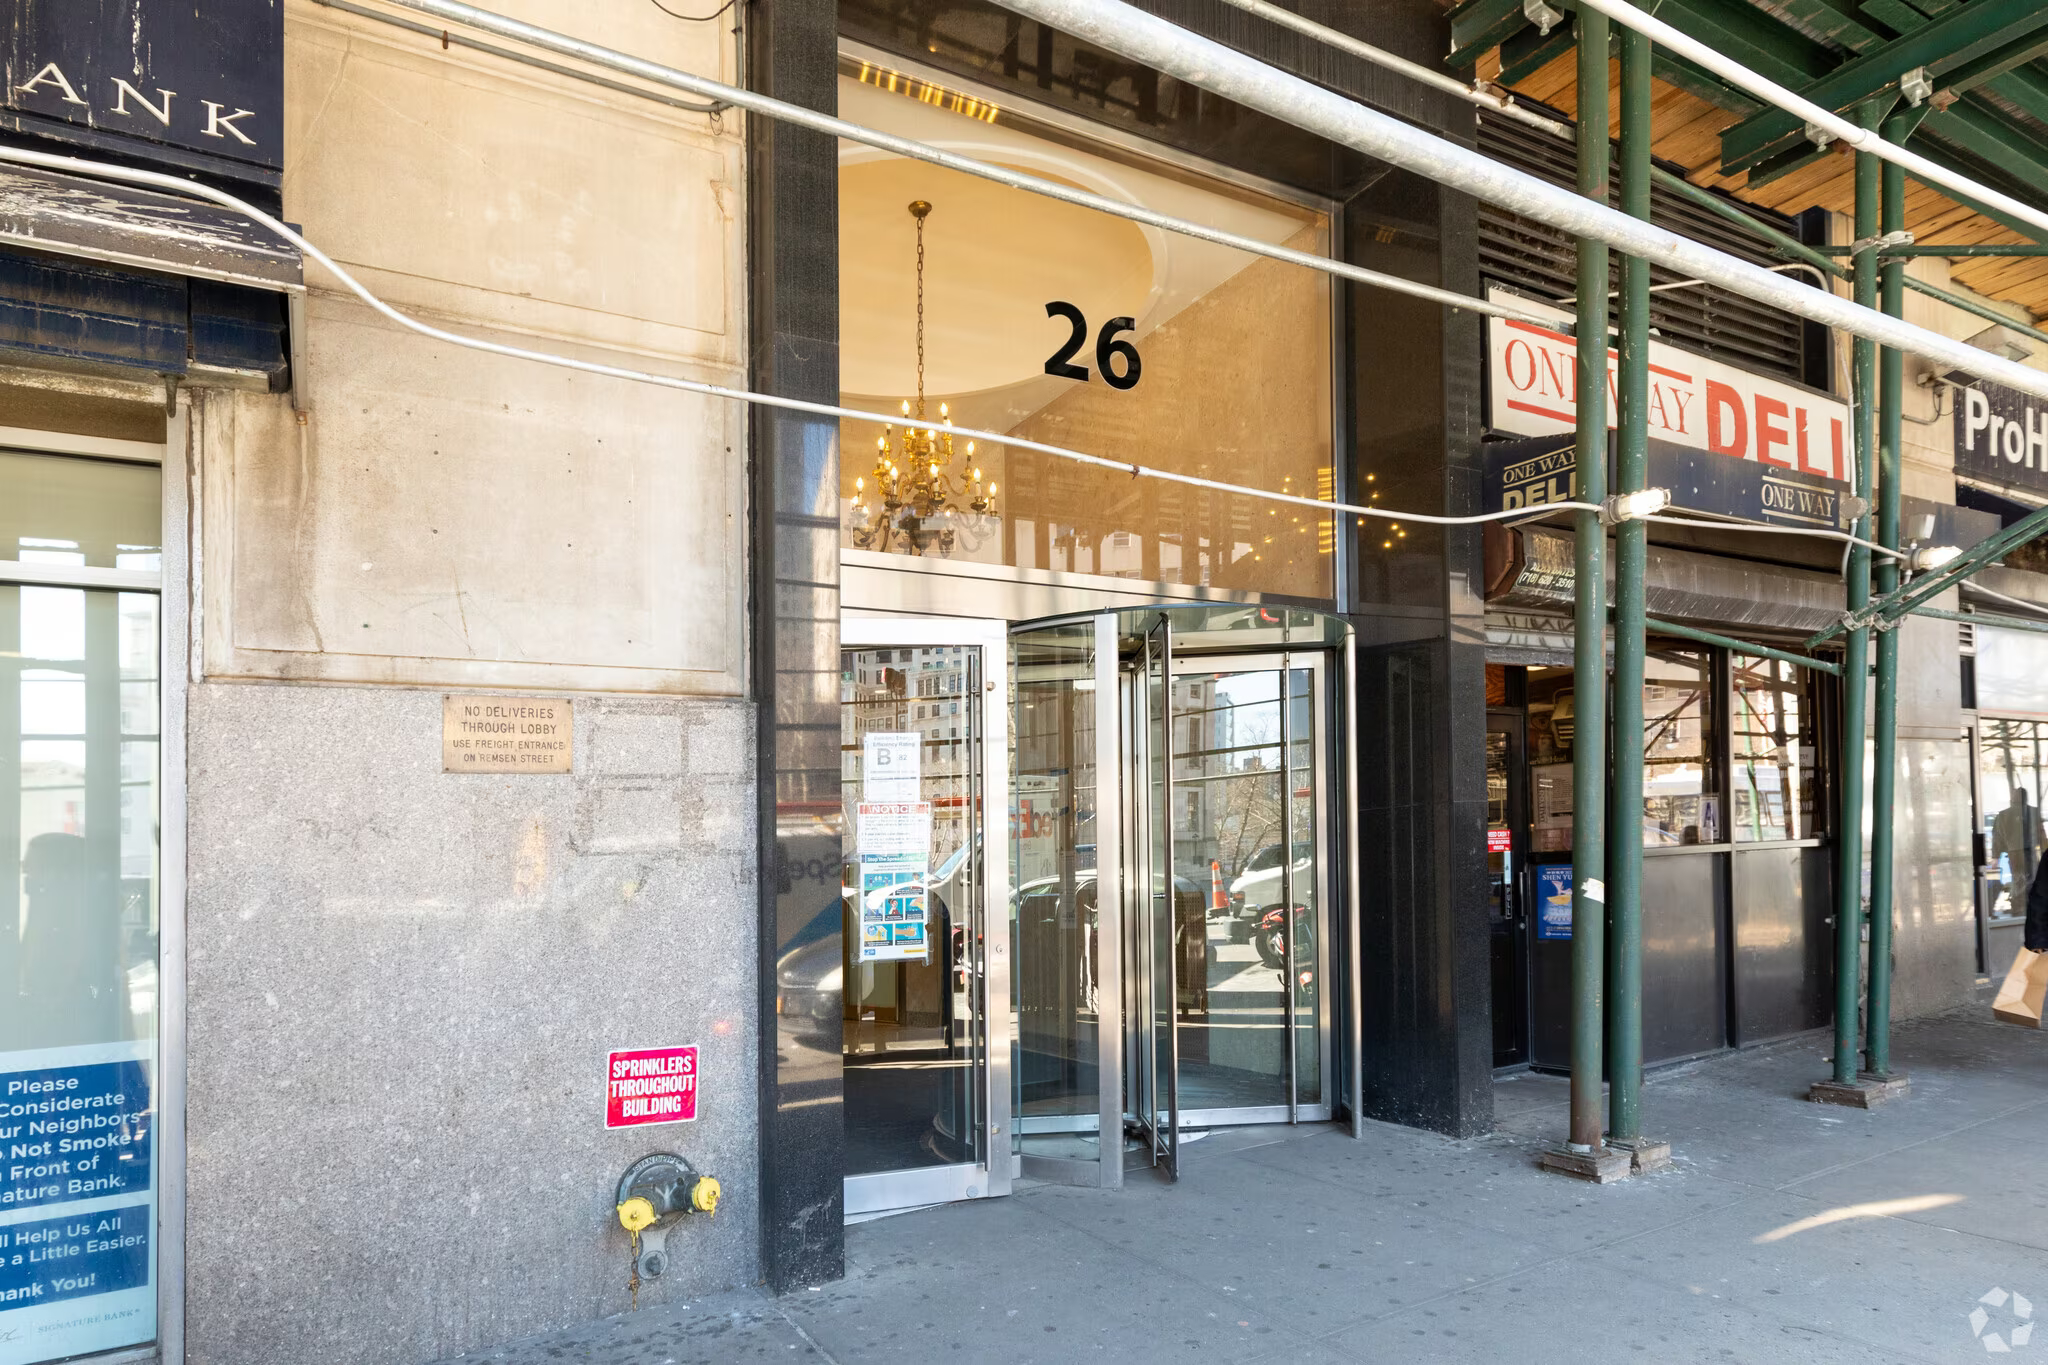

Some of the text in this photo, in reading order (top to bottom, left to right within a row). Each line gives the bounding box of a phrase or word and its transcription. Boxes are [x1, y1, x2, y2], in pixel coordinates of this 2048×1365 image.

[15, 62, 256, 145] ANK
[1044, 300, 1142, 391] 26
[1606, 367, 1694, 435] AY
[1706, 378, 1845, 481] DELI
[1965, 387, 2048, 472] ProH
[1503, 449, 1576, 484] ONE WAY
[1503, 472, 1576, 512] DELI
[1761, 483, 1835, 517] ONE WAY
[464, 706, 554, 719] NO DELIVERIES
[461, 721, 557, 735] THROUGH LOBBY
[453, 739, 564, 750] USE FREIGHT ENTRANCE
[877, 748, 892, 766] B
[463, 753, 554, 763] ON REMSEN STREET
[871, 804, 916, 814] NOTICE
[1703, 801, 1717, 828] A
[612, 1055, 693, 1078] SPRINKLERS
[8, 1078, 79, 1096] Please
[610, 1074, 695, 1098] THROUGHOUT
[622, 1095, 682, 1118] BUILDING
[29, 1113, 141, 1136] Neighbors
[11, 1141, 52, 1159] Not
[59, 1132, 132, 1153] Smoke
[10, 1160, 70, 1181] Front
[77, 1155, 100, 1172] of
[0, 1173, 126, 1203] ature Bank.
[15, 1228, 60, 1246] Help
[67, 1223, 90, 1237] Us
[96, 1217, 121, 1233] All
[11, 1254, 23, 1266] a
[29, 1243, 80, 1263] Little
[86, 1234, 147, 1254] Easier.
[51, 1273, 96, 1292] You!
[38, 1318, 101, 1333] SIGNATURE
